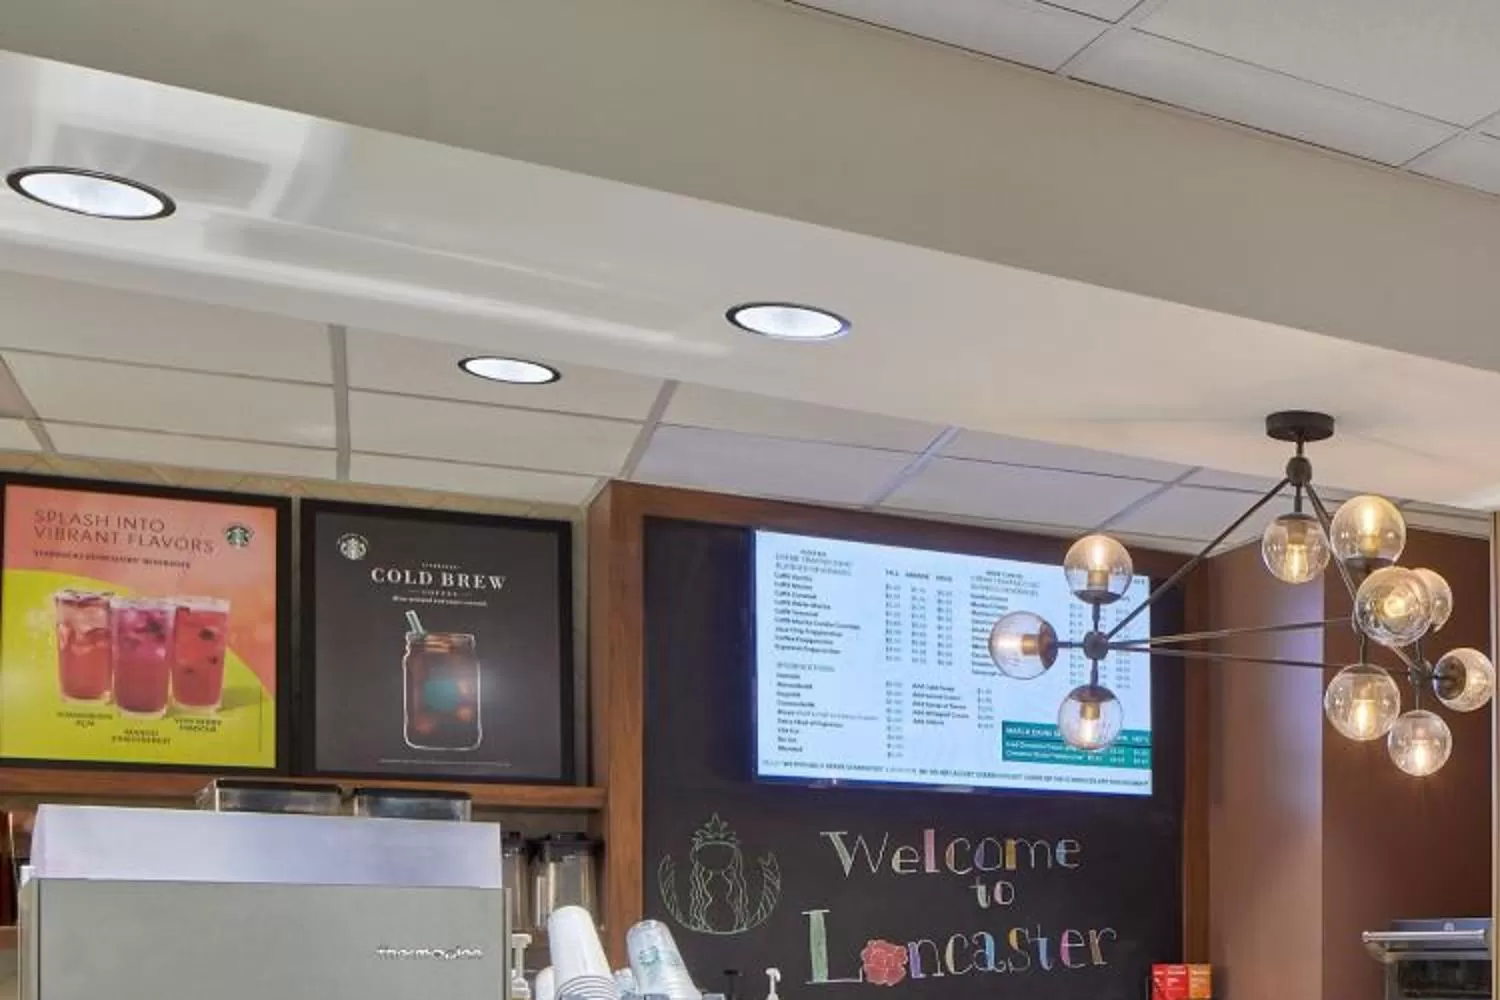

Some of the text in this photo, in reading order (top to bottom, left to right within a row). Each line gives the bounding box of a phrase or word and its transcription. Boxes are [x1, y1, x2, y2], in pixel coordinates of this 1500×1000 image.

[33, 510, 165, 533] SPLASH INTO
[32, 525, 215, 554] VIBRANT FLAVORS
[371, 567, 507, 590] COLD BREW
[820, 828, 1082, 878] Welcome
[969, 875, 1016, 908] to
[802, 909, 1118, 987] Lncaster
